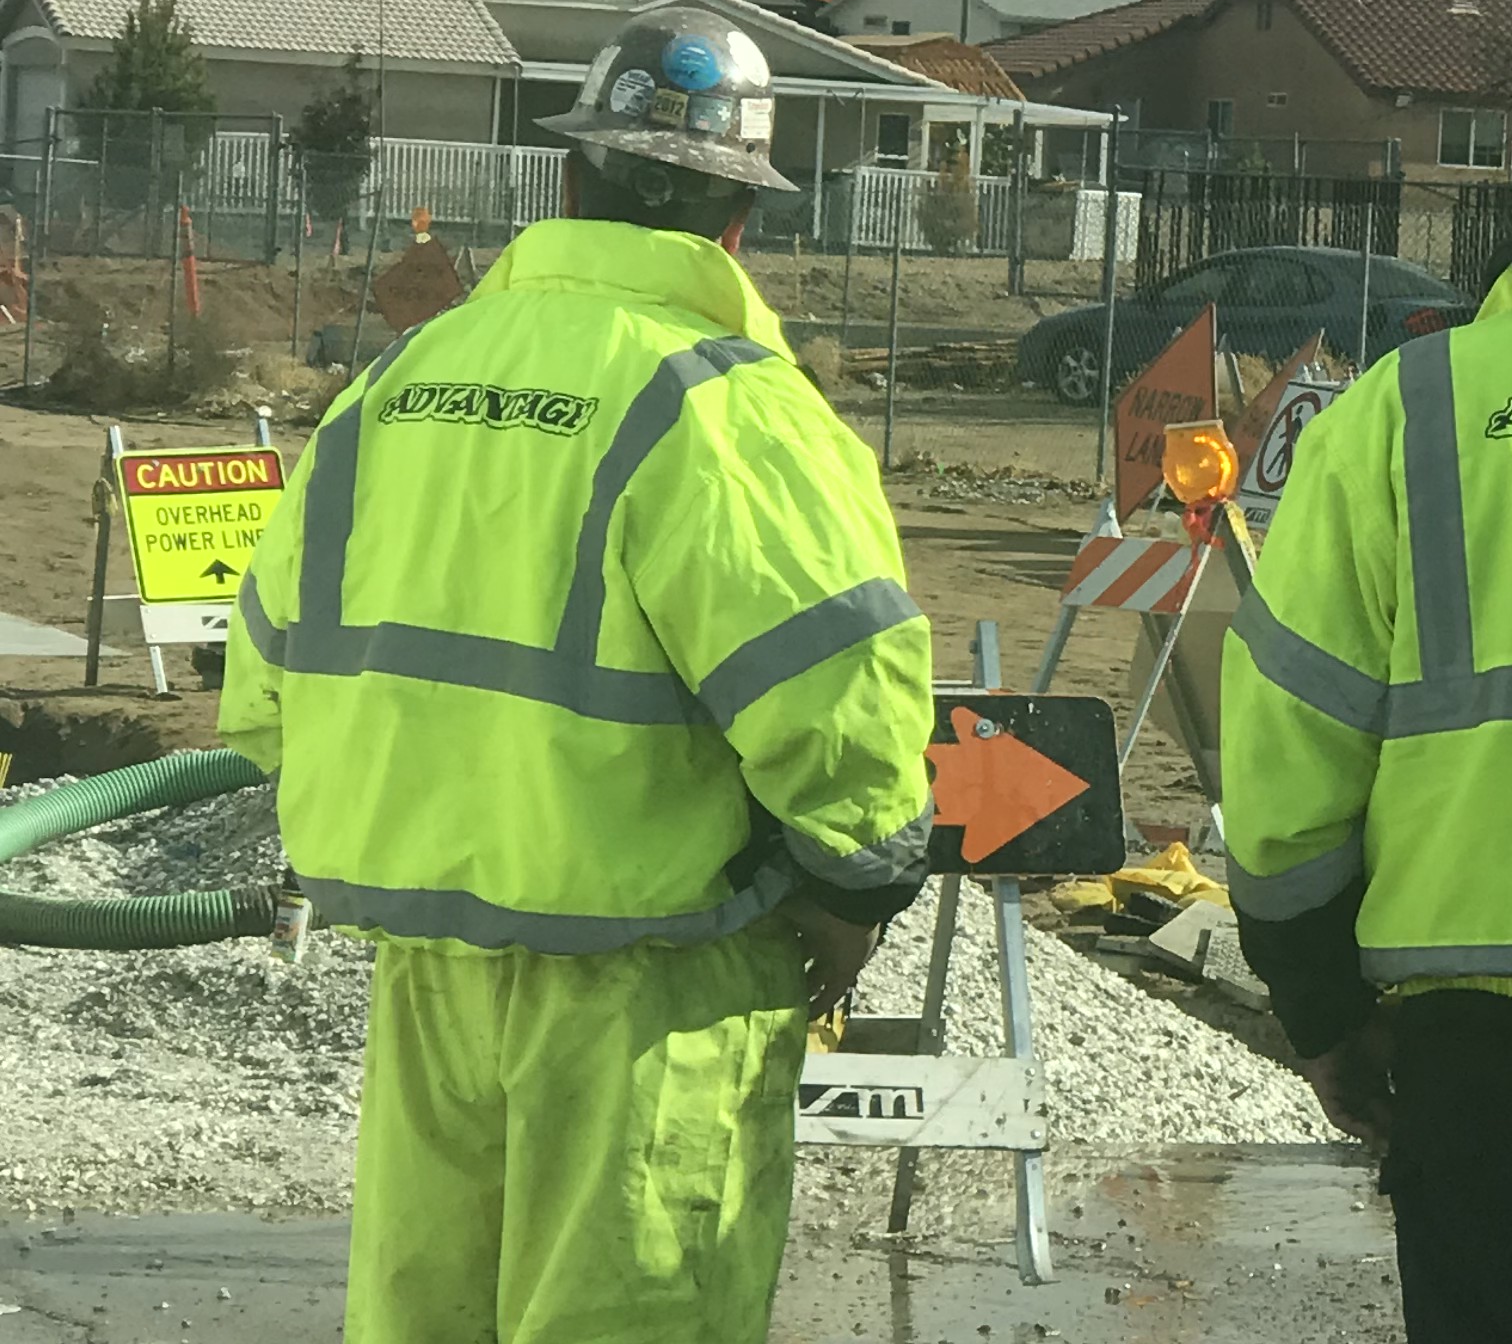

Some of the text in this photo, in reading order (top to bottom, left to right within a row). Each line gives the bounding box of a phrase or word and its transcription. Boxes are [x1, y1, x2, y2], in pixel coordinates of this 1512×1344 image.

[1125, 431, 1166, 467] LAN
[137, 459, 269, 489] CAUTION
[156, 503, 262, 526] OVERHEAD
[146, 528, 264, 553] POWER LIN
